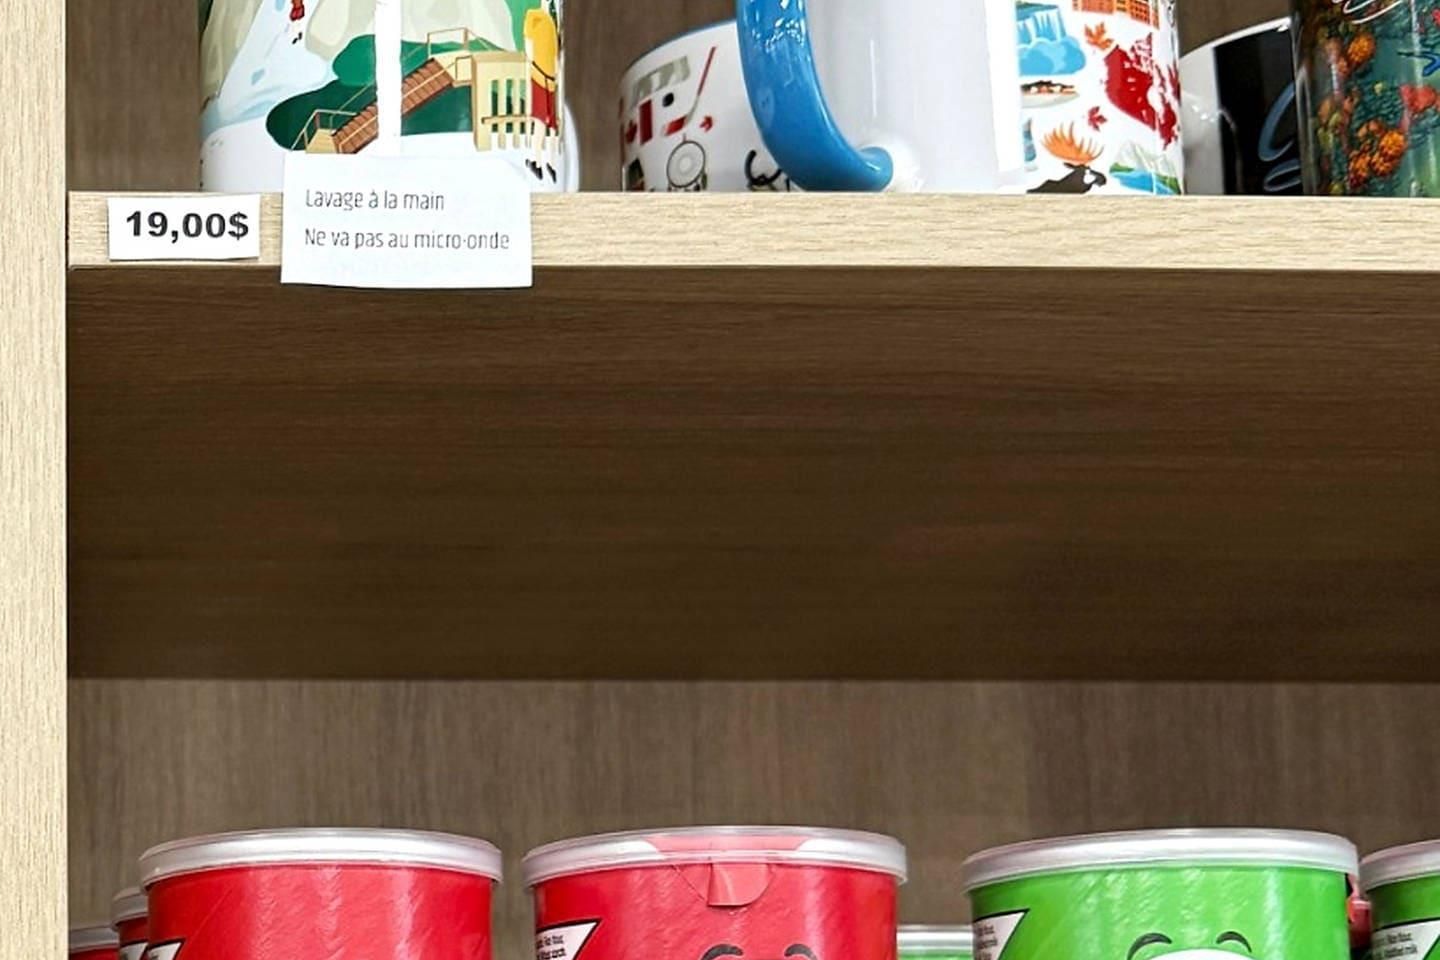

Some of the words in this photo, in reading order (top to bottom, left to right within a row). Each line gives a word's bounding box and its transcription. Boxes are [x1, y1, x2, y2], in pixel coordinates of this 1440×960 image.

[305, 189, 364, 211] Lavage
[369, 189, 379, 208] à
[384, 191, 399, 209] la
[403, 192, 445, 210] main
[126, 210, 249, 243] 19,00$
[305, 228, 326, 247] Ne
[331, 232, 350, 247] va
[354, 232, 384, 250] pas
[388, 232, 410, 247] au
